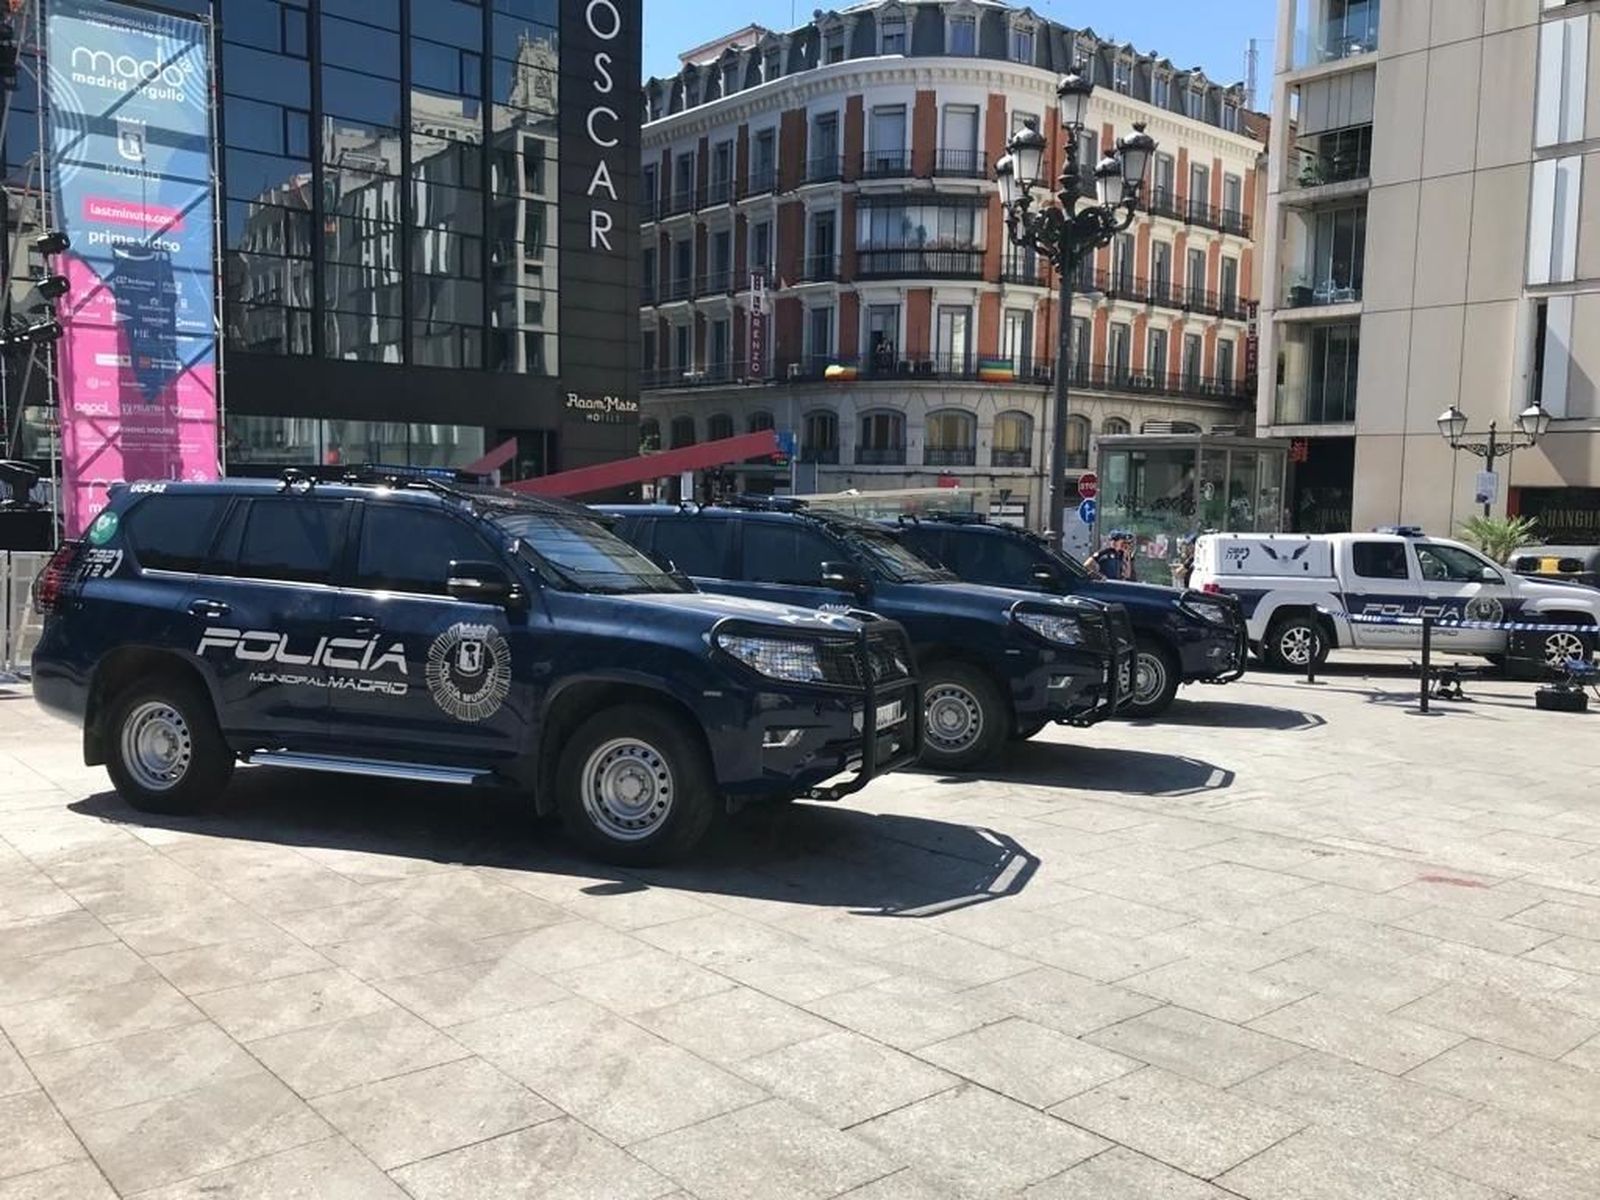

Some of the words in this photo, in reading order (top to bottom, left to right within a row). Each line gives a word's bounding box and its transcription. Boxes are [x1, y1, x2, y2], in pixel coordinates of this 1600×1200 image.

[71, 46, 184, 87] mado
[72, 72, 127, 91] madrid
[586, 0, 621, 250] OSCAR
[88, 230, 134, 246] prime
[137, 234, 181, 253] video
[196, 627, 408, 676] POLICÍA
[326, 676, 408, 696] MADRID
